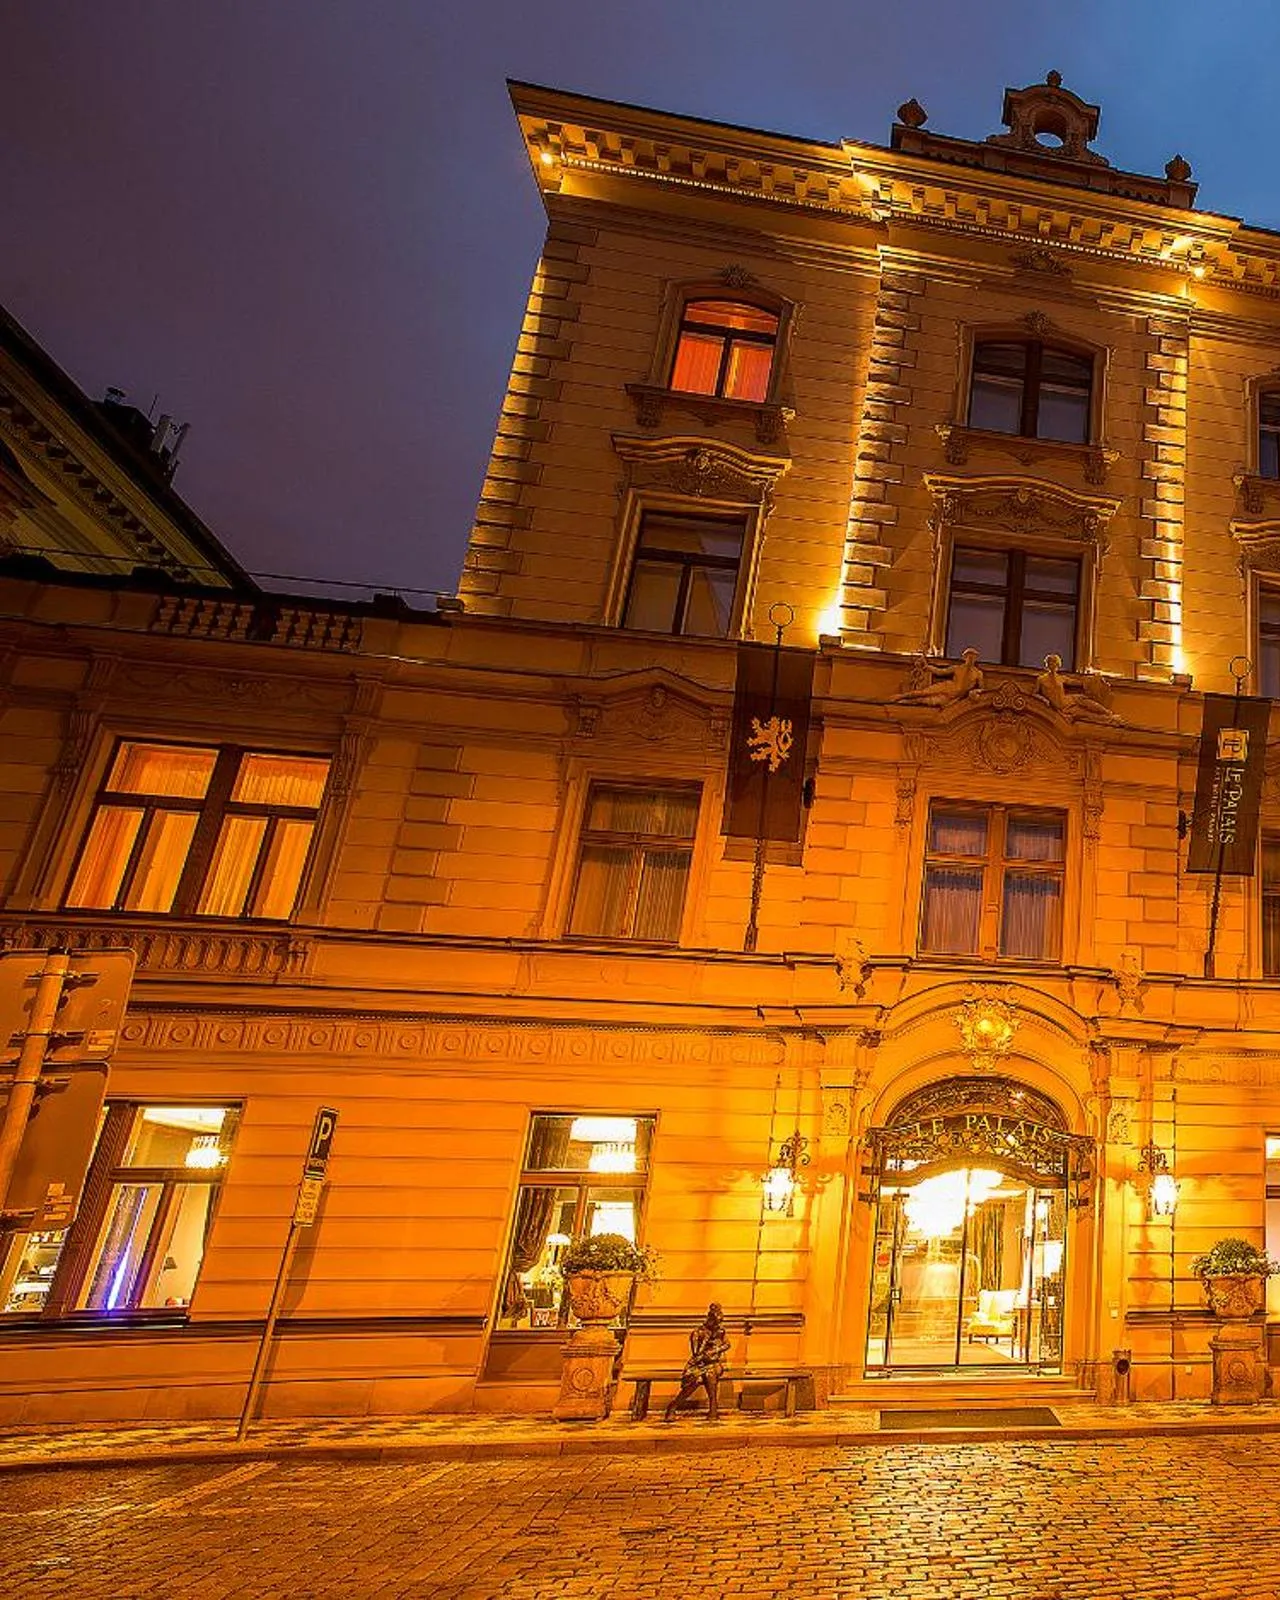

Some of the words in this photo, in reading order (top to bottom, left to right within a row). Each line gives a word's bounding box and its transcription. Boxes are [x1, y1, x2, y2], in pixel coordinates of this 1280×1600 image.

[1219, 784, 1243, 844] PALAIS
[314, 1117, 332, 1154] P
[914, 1118, 946, 1139] LE
[965, 1115, 1053, 1144] PALAIS
